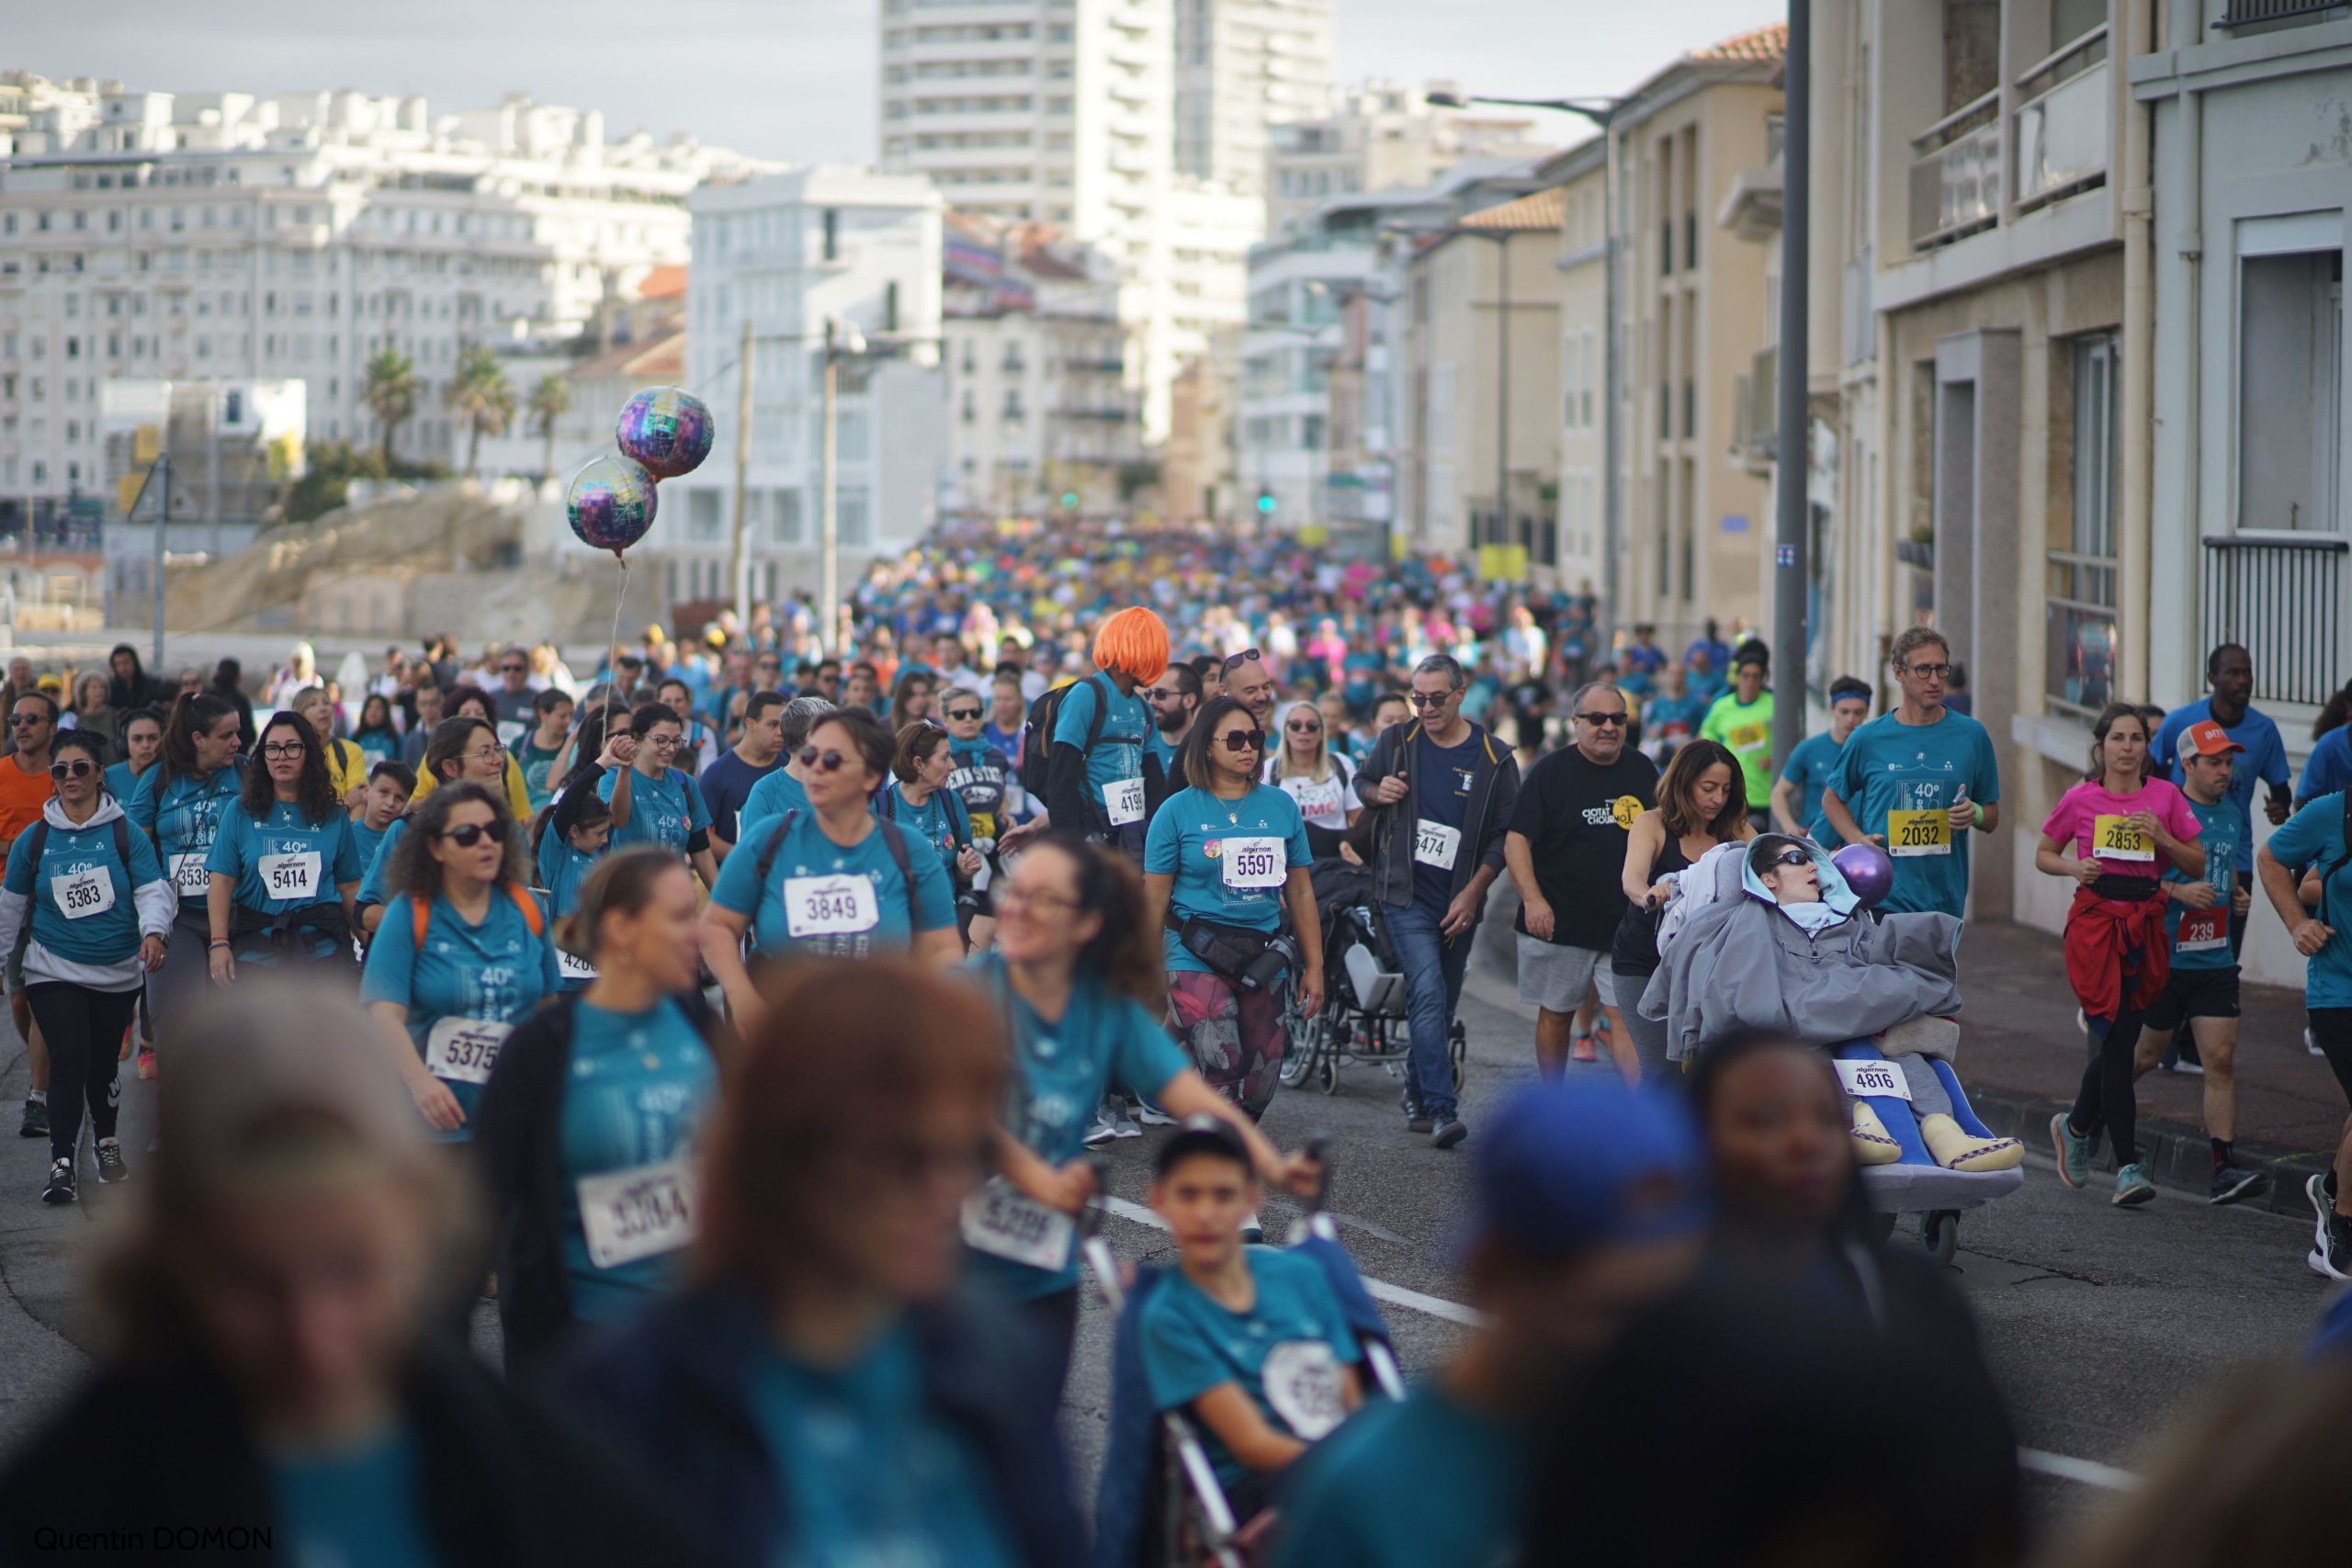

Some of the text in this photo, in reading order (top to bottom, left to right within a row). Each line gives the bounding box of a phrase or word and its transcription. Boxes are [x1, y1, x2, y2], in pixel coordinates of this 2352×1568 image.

[945, 767, 974, 790] ENN
[1582, 807, 1611, 818] CIOTAT
[1902, 826, 1939, 846] 2032
[2106, 830, 2142, 851] 2853
[1241, 846, 1272, 854] algernon
[277, 862, 306, 870] algernon
[1238, 854, 1274, 876] 5597
[68, 878, 96, 889] algernon
[180, 868, 211, 886] 3538
[273, 869, 308, 889] 5414
[66, 885, 101, 909] 5383
[806, 896, 857, 920] 3849
[2189, 922, 2214, 942] 239
[446, 1039, 500, 1070] 5375
[1857, 1073, 1894, 1089] 4816
